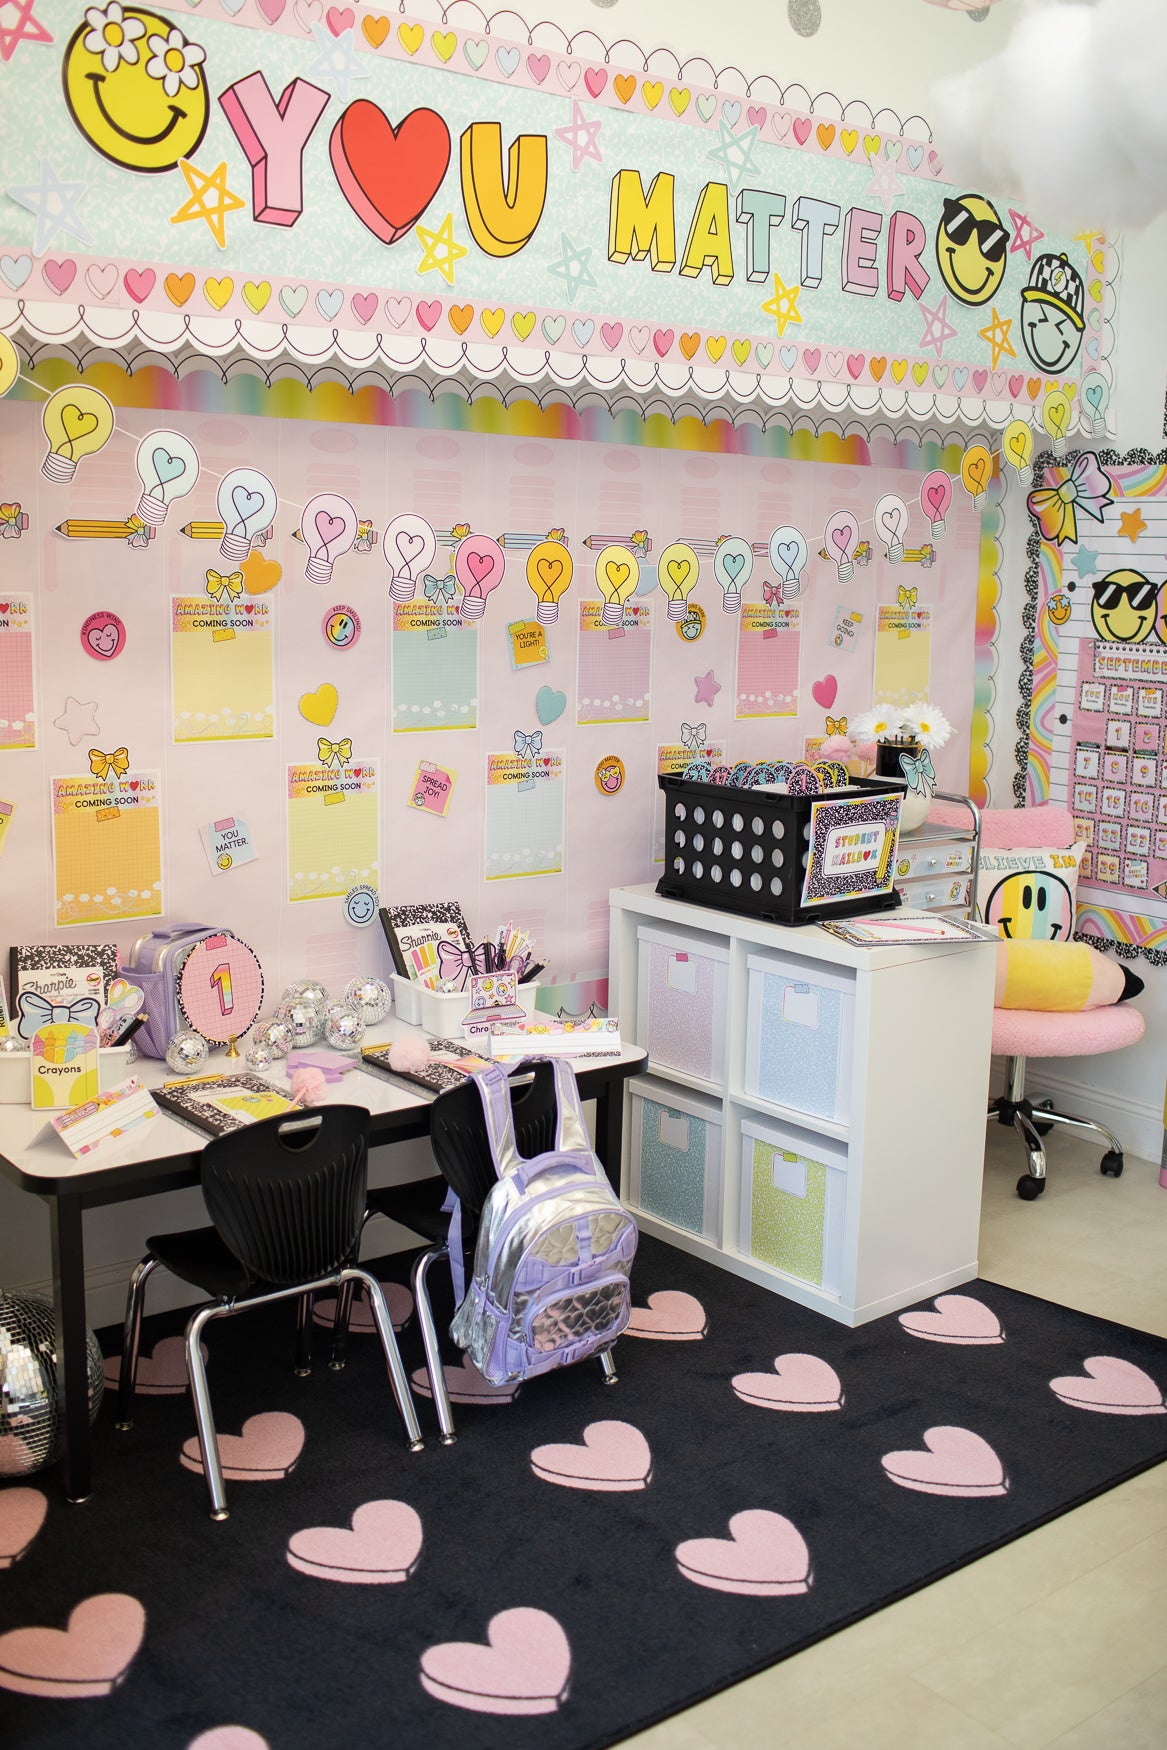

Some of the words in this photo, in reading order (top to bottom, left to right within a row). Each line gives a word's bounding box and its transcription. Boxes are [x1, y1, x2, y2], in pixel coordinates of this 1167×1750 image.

[607, 169, 930, 303] MATTER
[333, 605, 346, 613] KEEP
[192, 619, 228, 628] COMING
[230, 619, 254, 628] SOON
[410, 619, 441, 627] COMING
[442, 619, 463, 627] SOON
[515, 632, 537, 641] YOU'RE
[538, 630, 543, 638] A
[519, 639, 540, 649] LIGHT!
[1097, 656, 1167, 675] SEPTEMBE
[1115, 727, 1122, 740] 1
[1143, 730, 1152, 743] 2
[502, 772, 531, 780] COMING
[531, 770, 550, 779] SOON
[1084, 757, 1091, 770] 7
[1111, 761, 1119, 774] 8
[1140, 765, 1149, 778] 9
[305, 784, 338, 794] COMING
[339, 782, 362, 791] SOON
[421, 775, 448, 792] SPREAD
[423, 786, 440, 799] JOY!
[75, 798, 112, 808] COMING
[114, 796, 139, 805] SOON
[1078, 790, 1093, 804] 14
[1106, 795, 1120, 809] 15
[1134, 799, 1150, 814] 16
[220, 829, 239, 841] YOU
[835, 831, 880, 849] STUDENT
[1076, 823, 1091, 838] 21
[1101, 828, 1118, 843] 22
[1158, 837, 1167, 851] 2
[215, 837, 249, 853] MATTER.
[1050, 854, 1077, 869] IN
[1099, 860, 1117, 875] 29
[400, 931, 441, 952] Sharpie
[22, 976, 77, 995] Sharpie
[210, 963, 234, 1016] 1
[38, 1065, 82, 1076] Crayons
